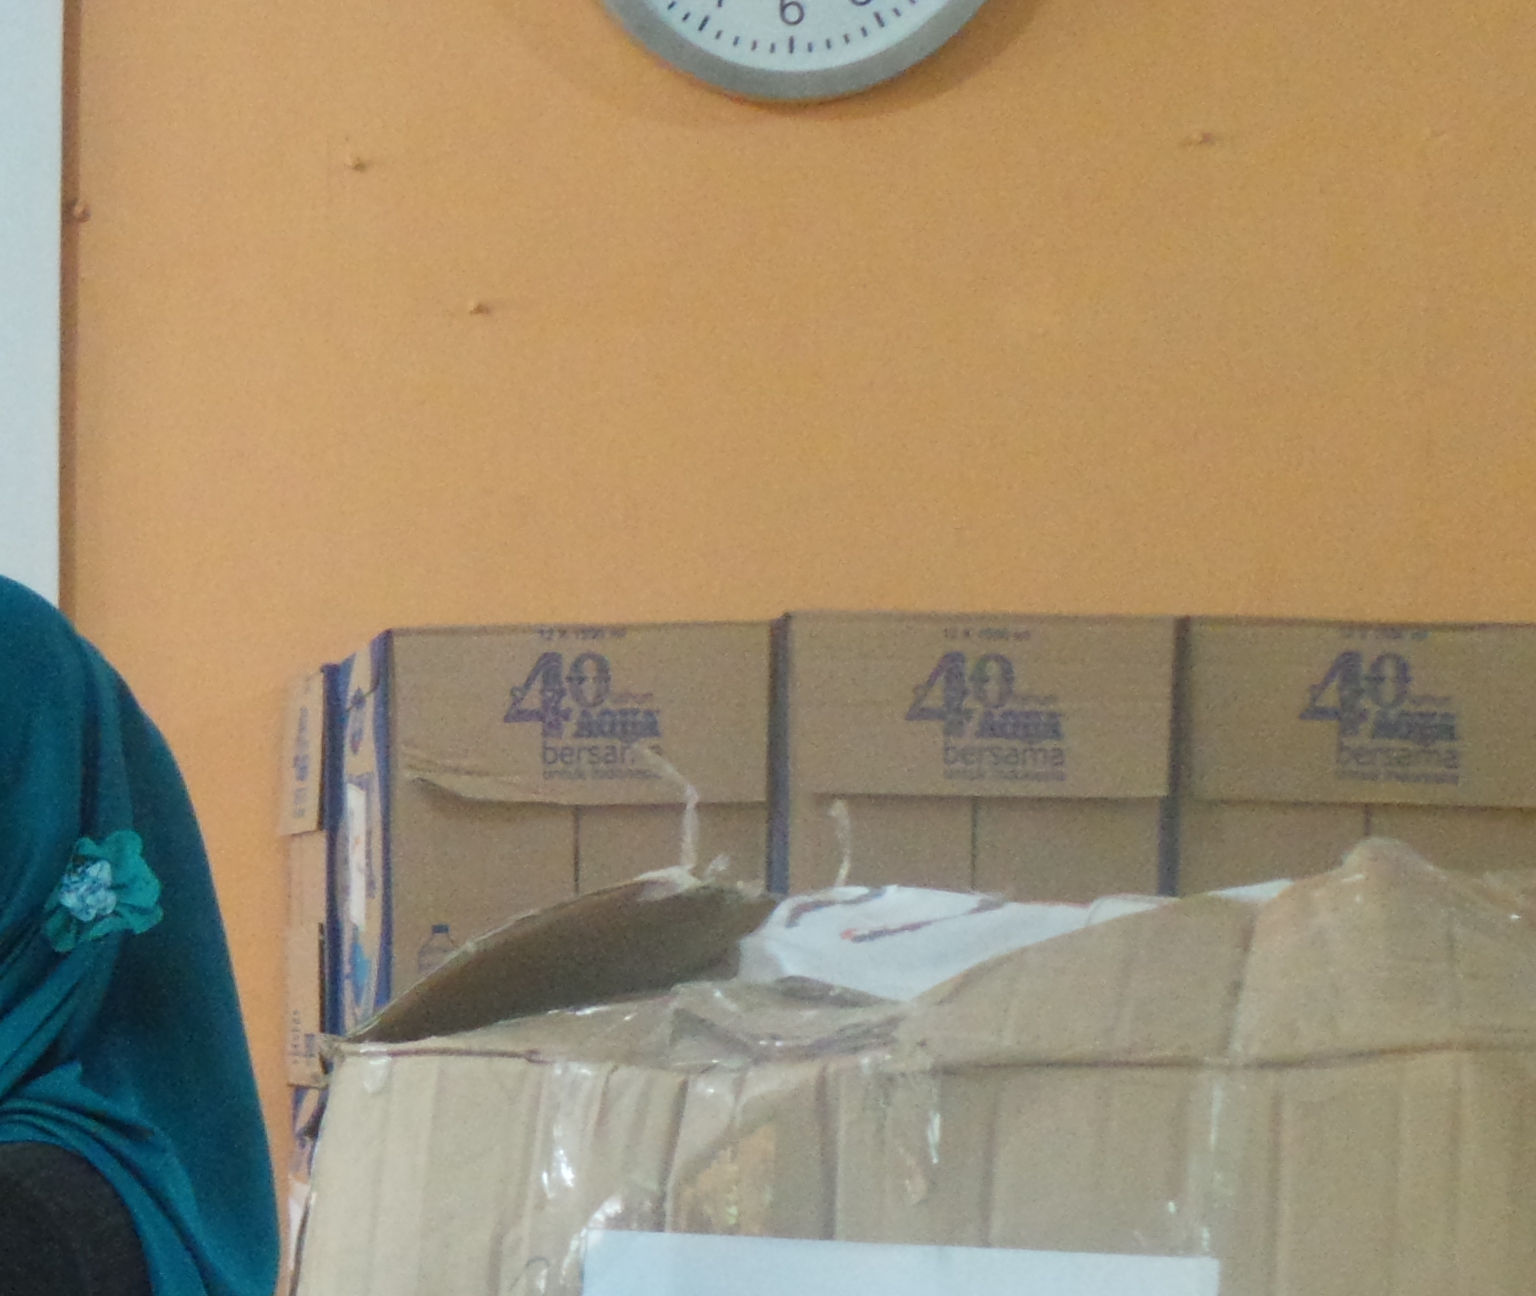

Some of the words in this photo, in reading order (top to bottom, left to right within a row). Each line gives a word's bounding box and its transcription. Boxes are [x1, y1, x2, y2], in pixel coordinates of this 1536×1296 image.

[504, 651, 612, 739] 40
[905, 651, 1016, 738] 40
[1298, 651, 1413, 737] 40
[943, 739, 1066, 766] bersama
